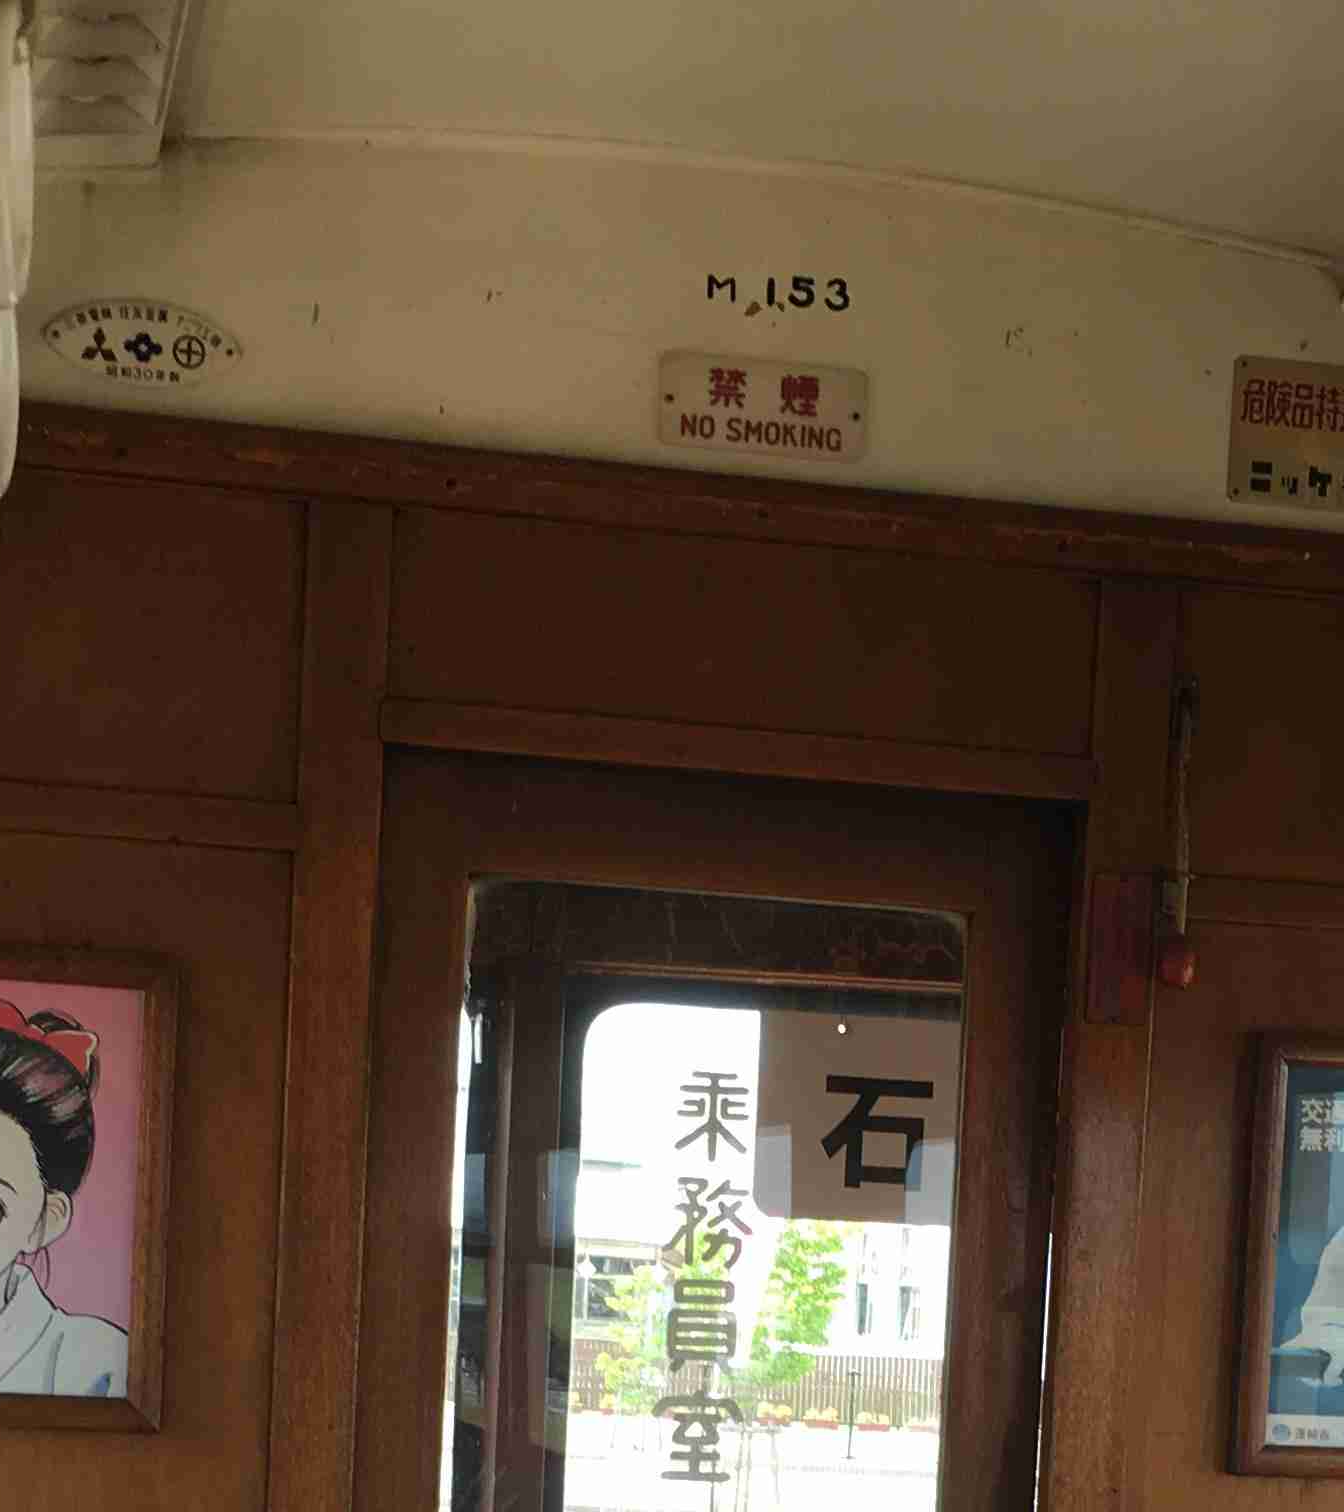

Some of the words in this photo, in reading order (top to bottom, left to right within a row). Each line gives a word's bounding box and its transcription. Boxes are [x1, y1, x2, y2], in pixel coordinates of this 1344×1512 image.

[709, 367, 820, 417] 禁煙
[680, 412, 716, 438] NO
[726, 417, 842, 452] SMOKING
[820, 1074, 934, 1189] 石
